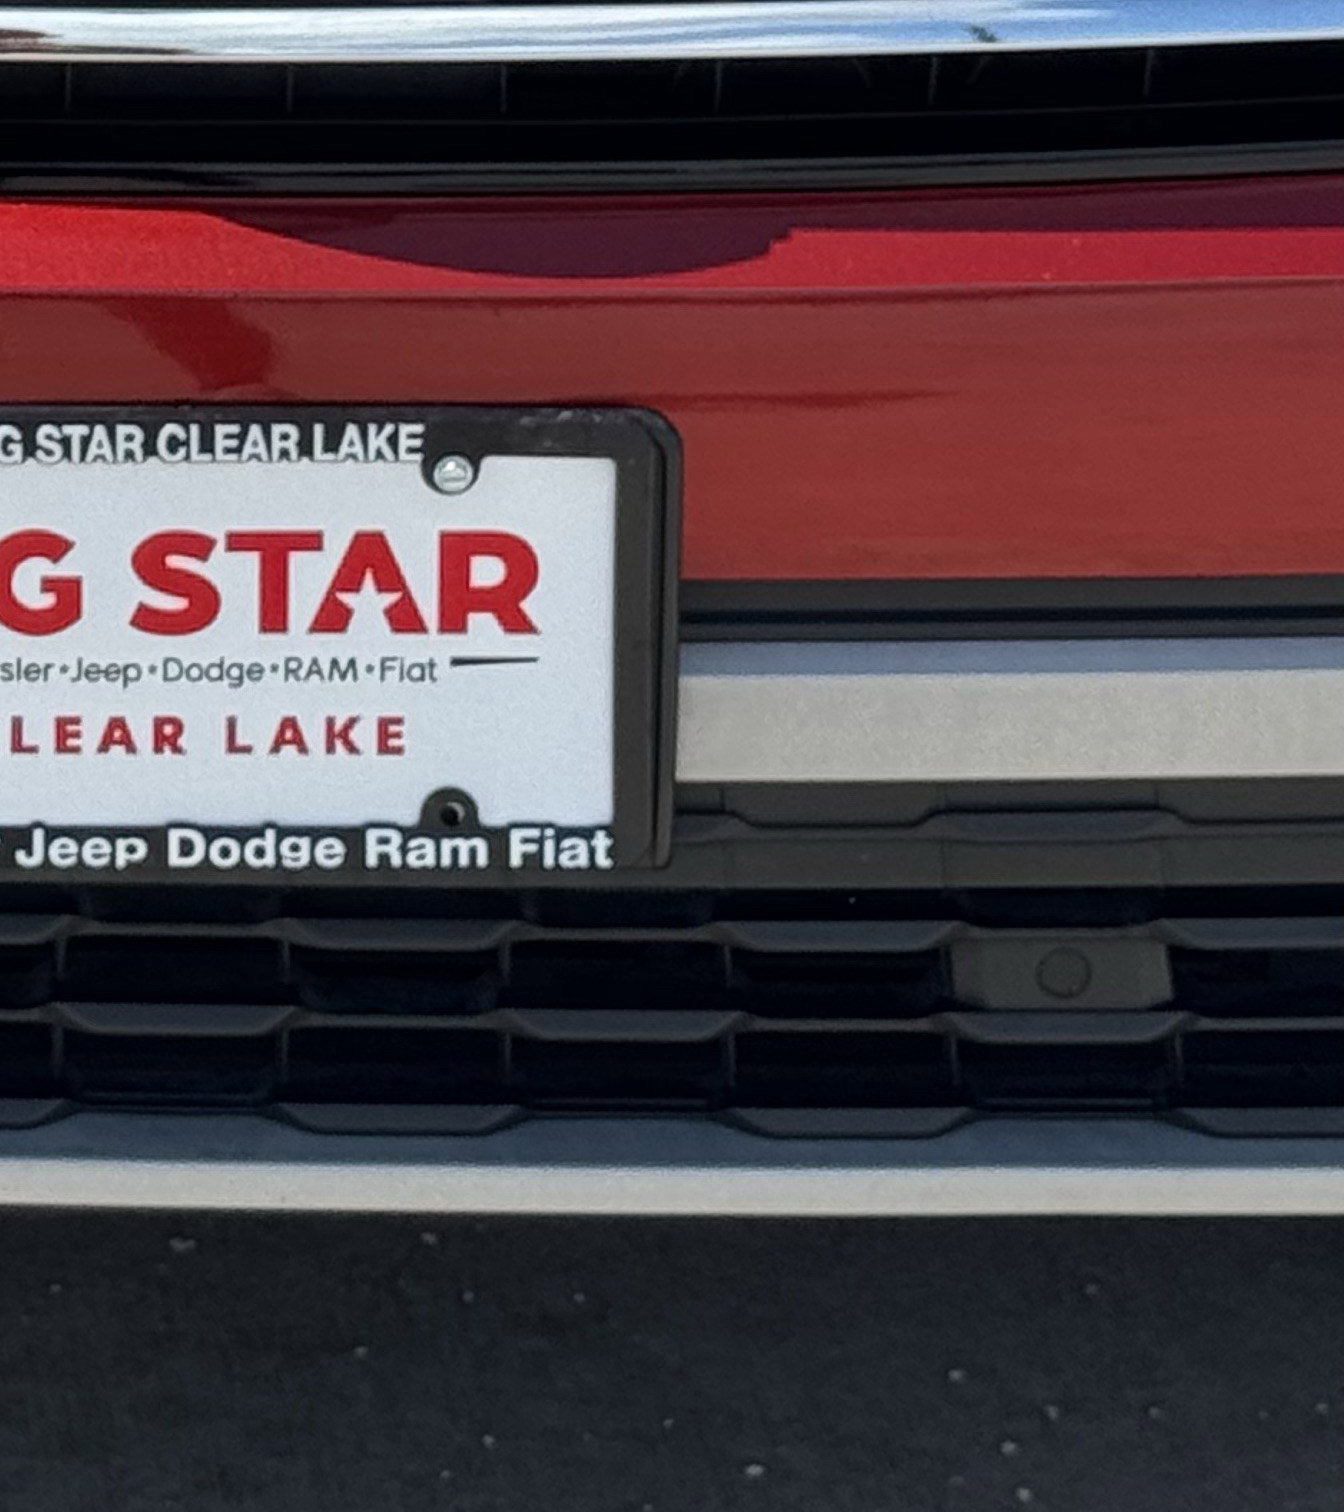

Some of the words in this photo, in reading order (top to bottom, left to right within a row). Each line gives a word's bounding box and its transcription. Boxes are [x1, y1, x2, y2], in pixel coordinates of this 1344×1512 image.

[35, 424, 145, 464] STAR
[156, 423, 300, 464] CLEAR
[312, 423, 425, 464] LAKE
[129, 529, 541, 635] STAR
[70, 656, 142, 688] Jeep
[163, 655, 265, 689] Dodge
[283, 657, 359, 683] RAM
[225, 714, 406, 756] LAKE
[15, 826, 149, 871] Jeep
[166, 825, 346, 871] Dodge
[364, 827, 488, 869] Ram
[509, 825, 614, 869] Fiat
